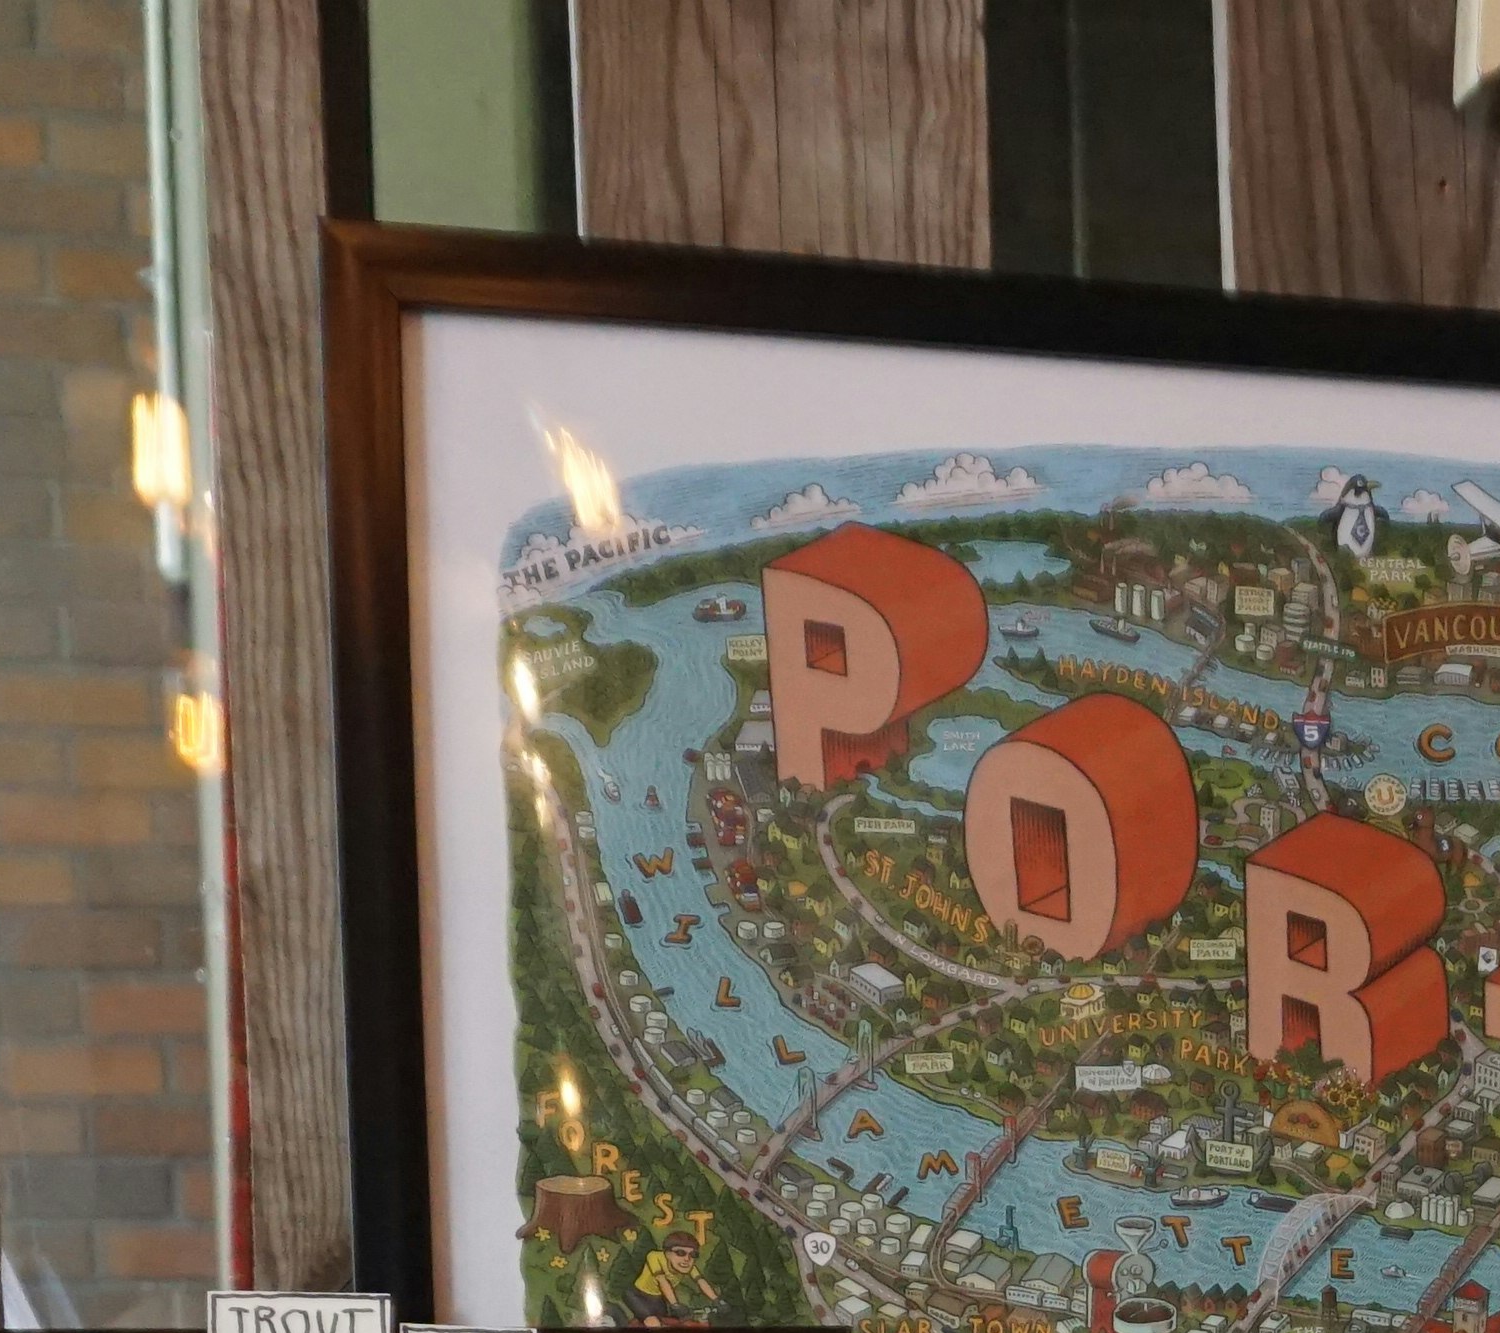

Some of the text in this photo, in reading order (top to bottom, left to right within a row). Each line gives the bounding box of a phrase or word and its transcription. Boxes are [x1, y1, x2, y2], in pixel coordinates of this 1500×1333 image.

[504, 525, 672, 589] THE PACIFIC
[1056, 654, 1282, 732] HAYDEN ISLAND
[1302, 723, 1320, 743] 5
[899, 863, 990, 944] JOHNS
[908, 944, 1001, 987] LOMBARD
[1038, 1007, 1250, 1076] UNIVERSITY PARK
[535, 1090, 713, 1244] FOREST
[1208, 1154, 1252, 1168] PORTLAND
[810, 1238, 830, 1257] 30
